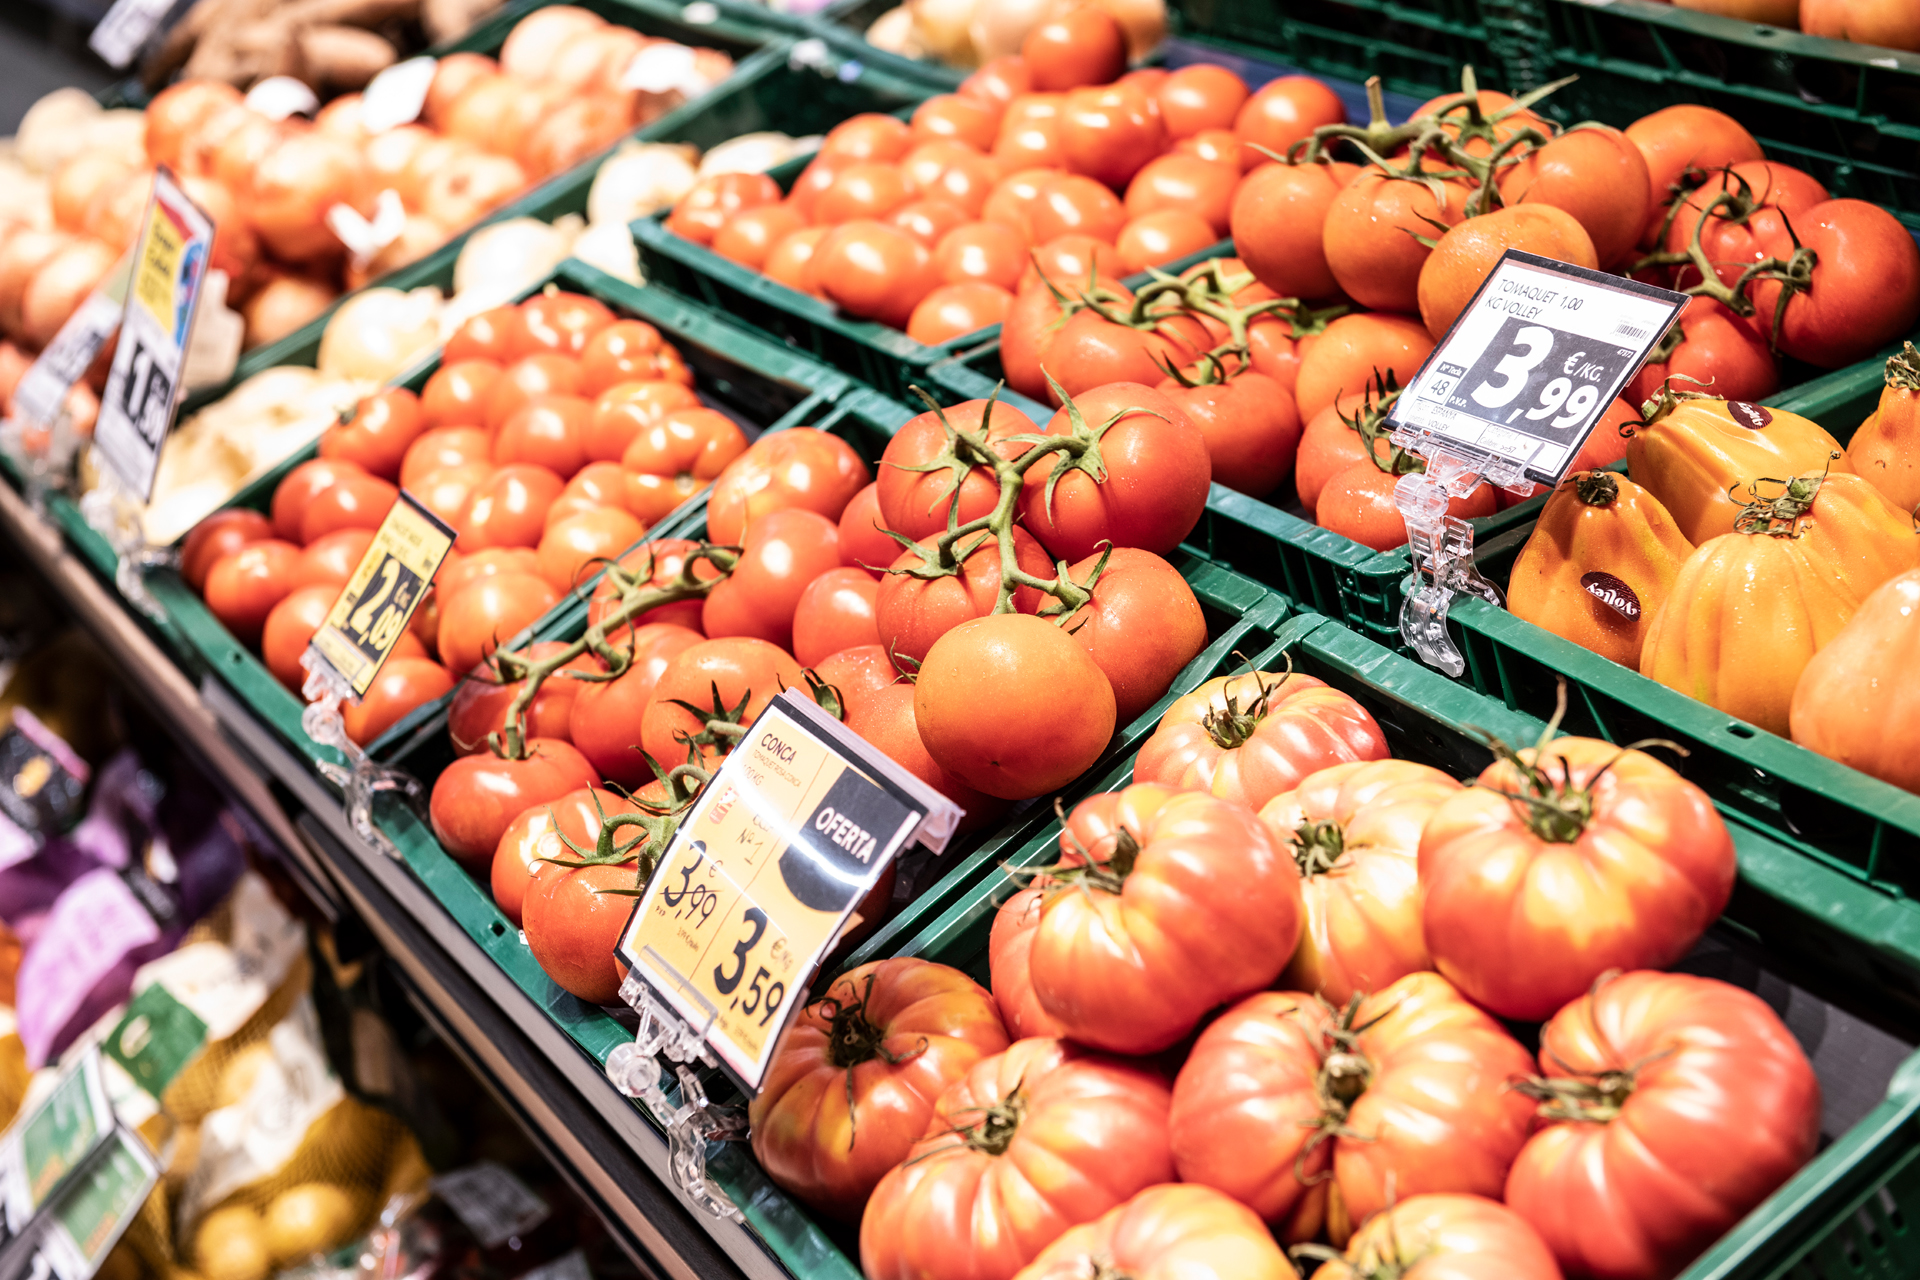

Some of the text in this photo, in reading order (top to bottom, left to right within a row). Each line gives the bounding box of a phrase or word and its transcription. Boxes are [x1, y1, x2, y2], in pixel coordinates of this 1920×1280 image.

[1485, 296, 1543, 320] KG VOLLEY
[1498, 279, 1584, 311] TOMAQUET 1,00
[1431, 379, 1450, 396] 48
[1471, 326, 1599, 429] 3,99
[1427, 419, 1450, 431] VOLLEY
[350, 558, 404, 651] 2,09
[761, 733, 797, 765] CONCA
[815, 806, 877, 865] OFERTA
[663, 840, 717, 930] 3,99
[713, 907, 784, 1027] 3,59
